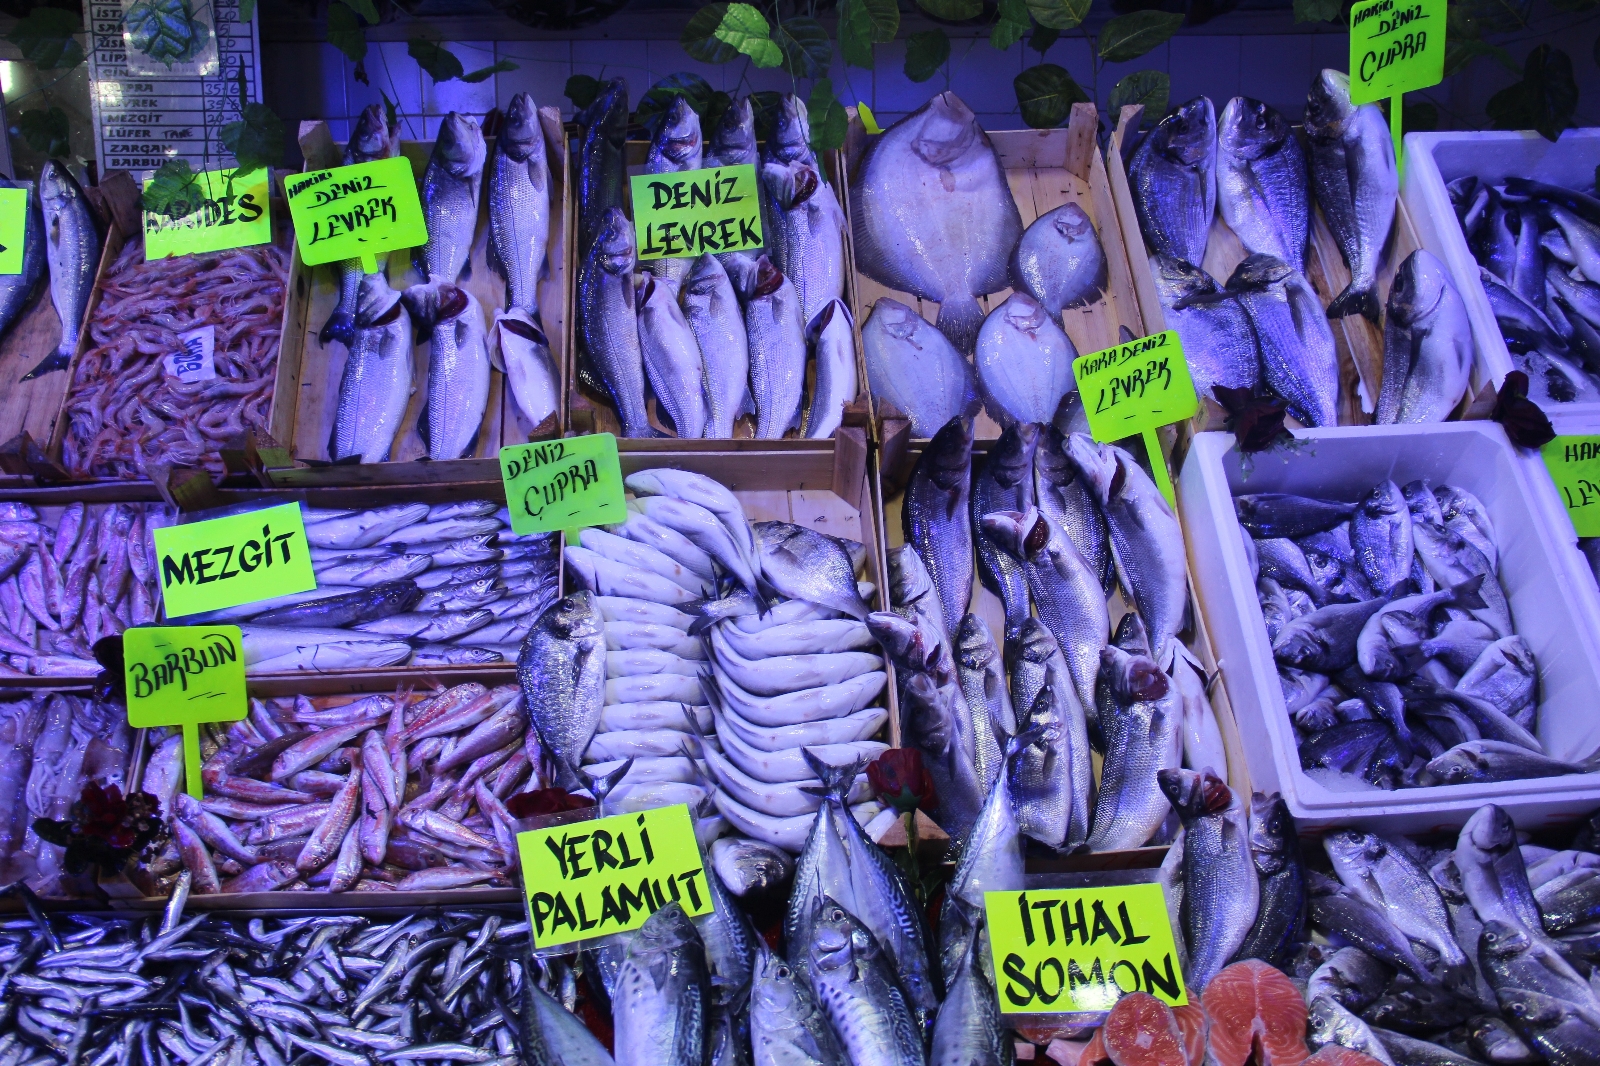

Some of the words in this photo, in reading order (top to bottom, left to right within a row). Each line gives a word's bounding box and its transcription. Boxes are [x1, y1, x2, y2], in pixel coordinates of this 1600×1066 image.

[205, 83, 248, 96] 35-6
[107, 112, 163, 124] MEZGİT
[108, 127, 152, 138] LÜFER
[647, 170, 744, 211] DENİZ
[309, 196, 396, 245] LEVREK
[640, 215, 762, 256] LEVREK
[1095, 357, 1172, 415] LEVREK
[162, 523, 296, 589] MEZGİT
[129, 633, 237, 699] BARBUN
[544, 813, 655, 881] YERLİ
[530, 867, 703, 939] PALAMUT
[1002, 952, 1181, 1007] SOMON
